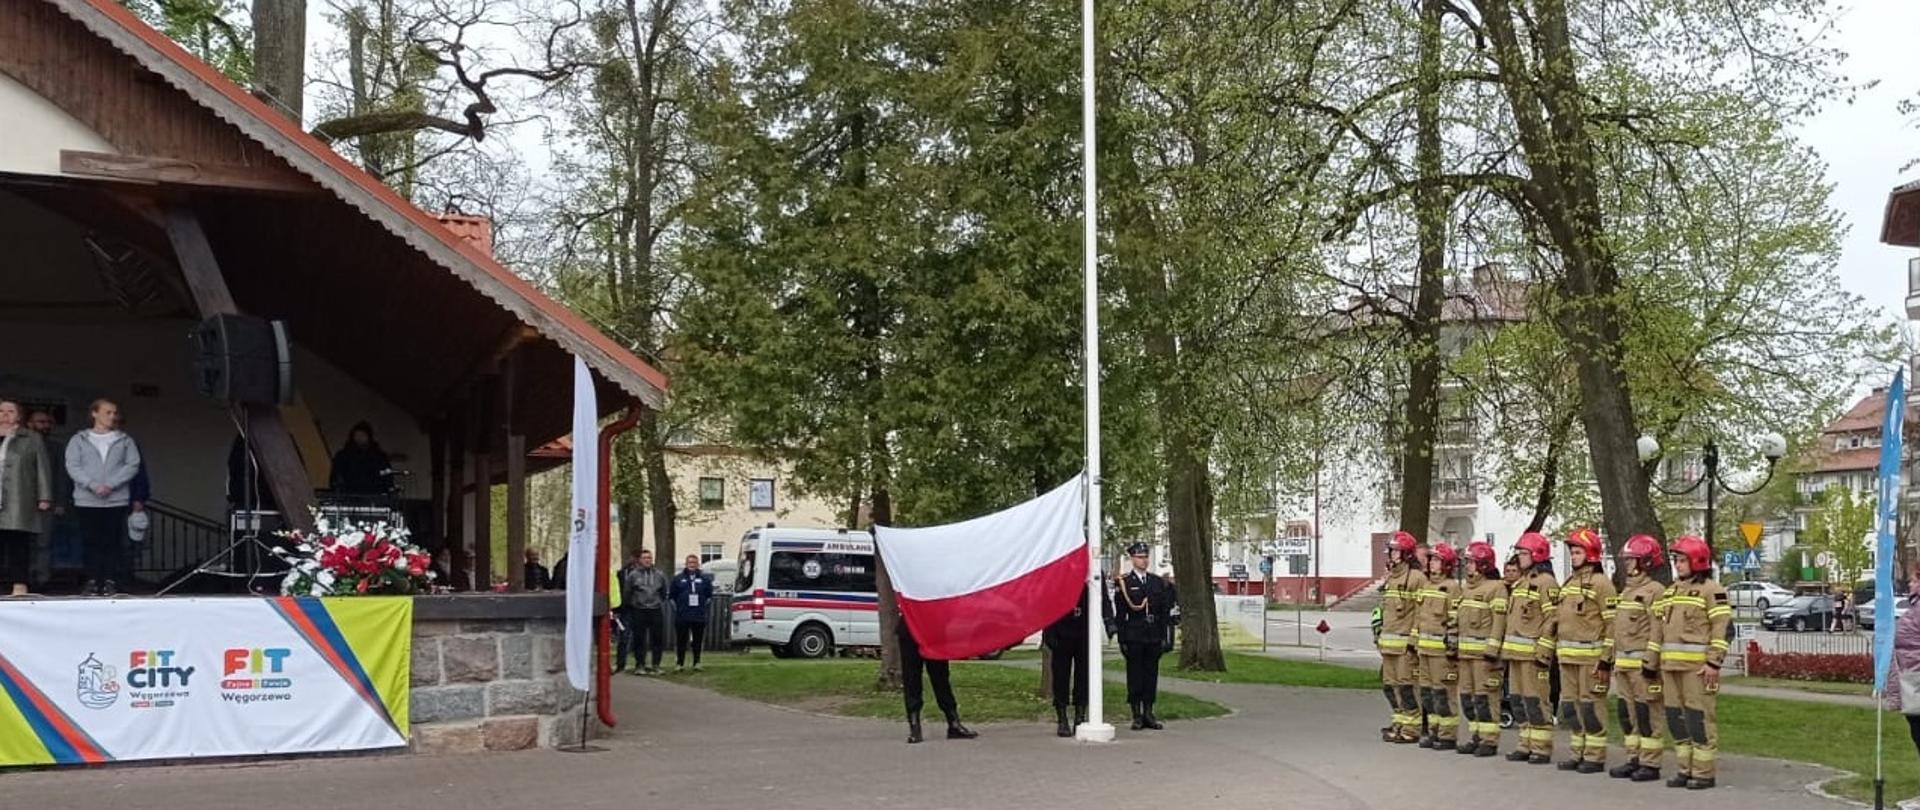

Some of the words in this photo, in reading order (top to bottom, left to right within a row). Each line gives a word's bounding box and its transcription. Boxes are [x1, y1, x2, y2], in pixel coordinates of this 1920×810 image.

[130, 650, 175, 669] FIT
[223, 648, 291, 677] FIT
[127, 666, 195, 688] CITY
[221, 692, 291, 704] Węgorzewo
